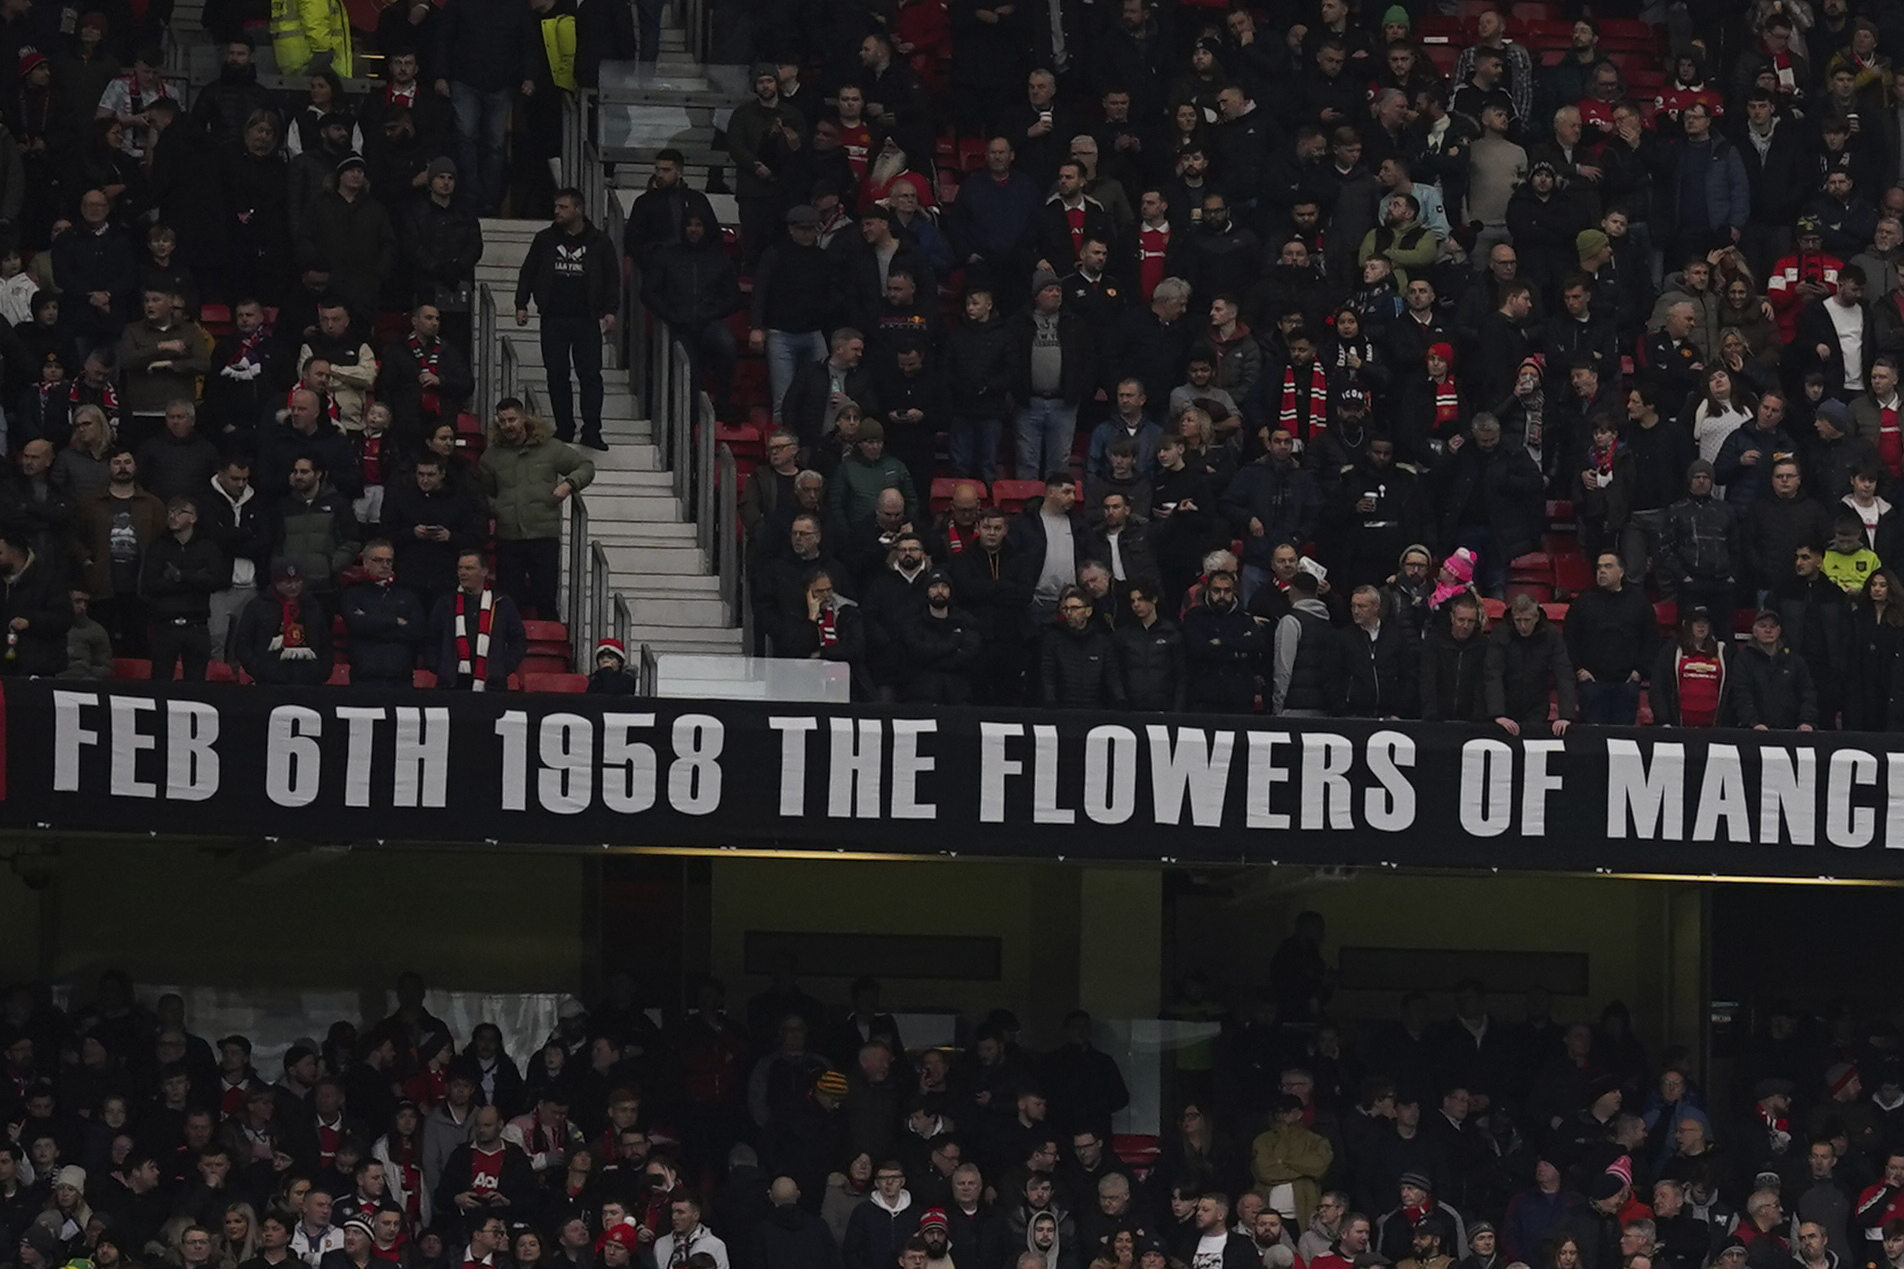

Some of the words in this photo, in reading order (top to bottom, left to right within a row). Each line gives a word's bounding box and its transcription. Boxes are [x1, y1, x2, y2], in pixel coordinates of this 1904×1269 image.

[54, 690, 219, 800] FEB
[267, 705, 449, 807] 6TH
[495, 710, 724, 814] 1958
[769, 717, 937, 818] THE
[980, 722, 1415, 831] FLOWERS
[1460, 739, 1565, 836] OF
